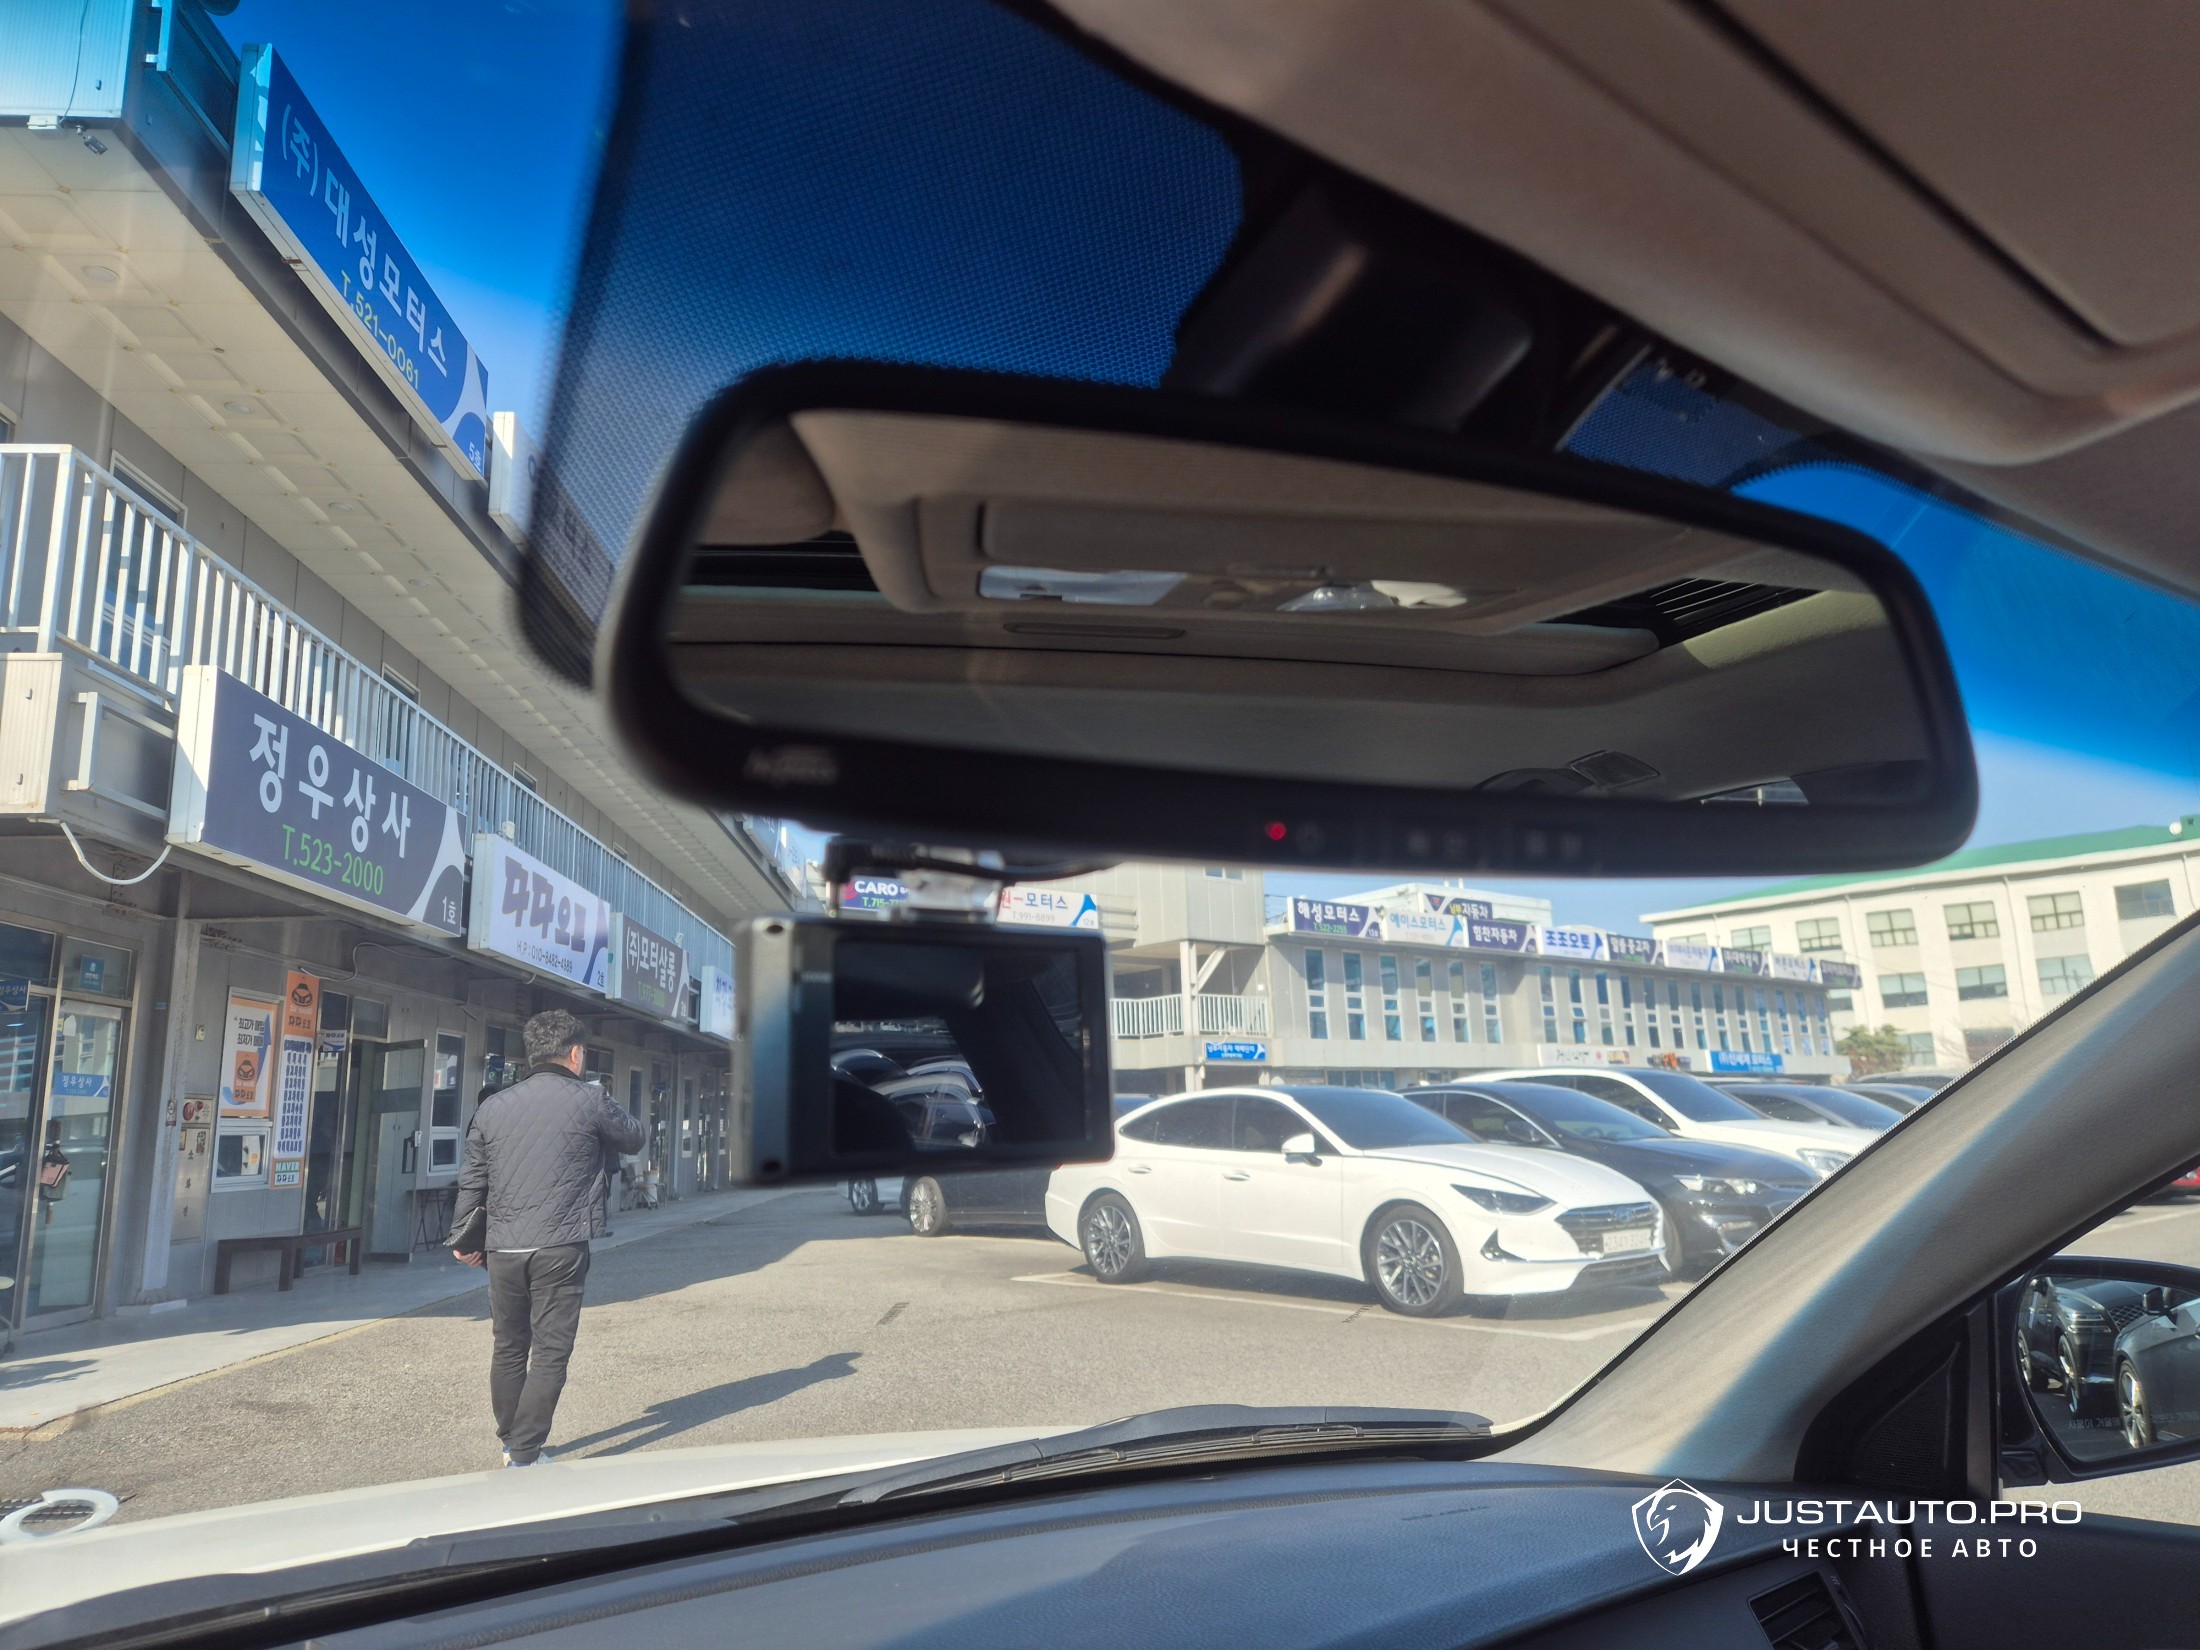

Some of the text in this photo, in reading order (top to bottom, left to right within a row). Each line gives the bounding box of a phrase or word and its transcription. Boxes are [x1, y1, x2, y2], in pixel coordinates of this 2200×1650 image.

[249, 713, 411, 859] 정우상사
[282, 823, 384, 897] T.523-2000
[854, 880, 899, 896] CARO
[442, 896, 456, 924] 1호
[1297, 901, 1361, 923] 해성모터스
[1389, 913, 1448, 931] 에이스모터스
[1472, 924, 1518, 945] 힘찬자동차
[1546, 930, 1591, 949] 조조오토
[62, 1075, 93, 1089] 정우상사
[275, 1161, 300, 1172] NAVER
